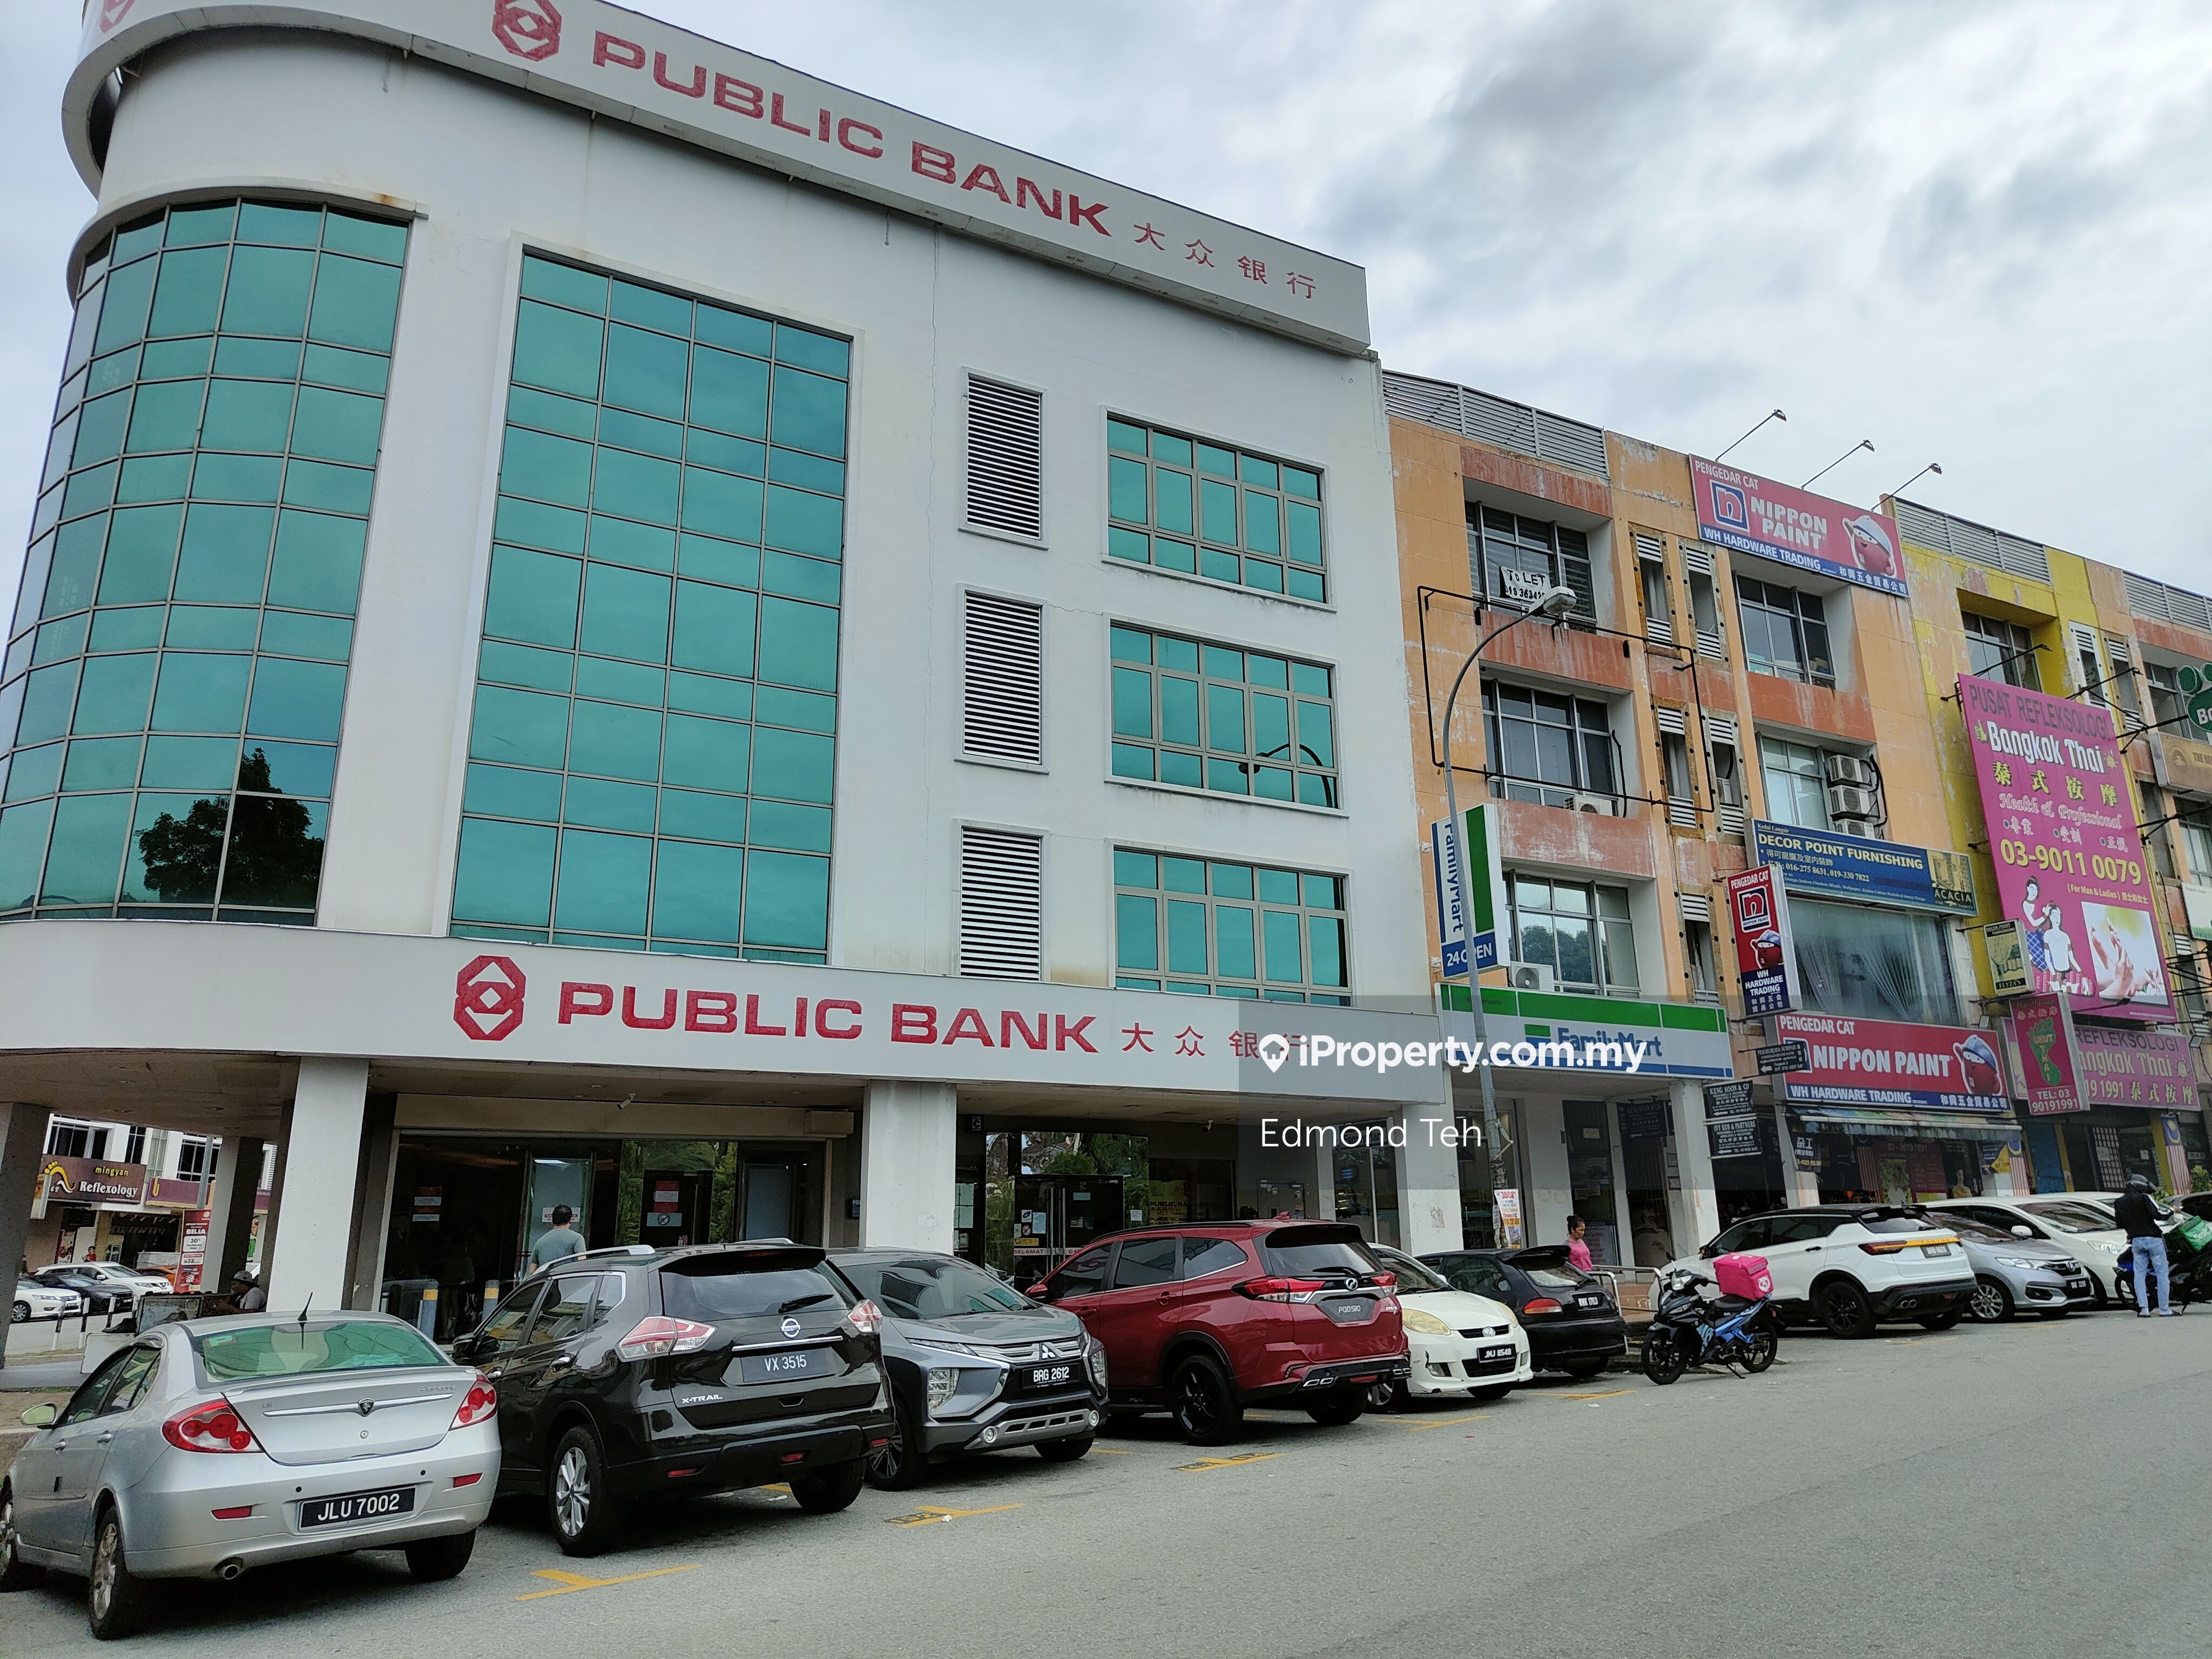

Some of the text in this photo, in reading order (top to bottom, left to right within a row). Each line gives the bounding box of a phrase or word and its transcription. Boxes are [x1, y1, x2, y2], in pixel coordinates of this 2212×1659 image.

[592, 30, 1111, 237] PUBLIC BANK
[1134, 221, 1316, 300] 大众银行
[1695, 460, 1759, 490] PENGEDAR CAT
[1751, 496, 1827, 534] NIPPON
[1762, 517, 1822, 549] PAINT
[1703, 527, 1821, 573] WH HARDWARE TRADING
[1506, 569, 1546, 586] TO LET
[1838, 566, 1906, 594] 和興五金貿易公司
[1968, 684, 2111, 741] PUSAT REFLEKSOLOGI
[1987, 720, 2106, 774] Bangkok Thai
[1992, 761, 2118, 807] 泰式按摩
[1999, 793, 2039, 814] Health
[2058, 804, 2122, 830] Professional
[1772, 826, 1789, 834] Langsir
[1758, 833, 1924, 870] DECOR POINT FURNISHING
[2000, 839, 2142, 885] 03-9011 0079
[1730, 870, 1769, 890] PENGEDAR CAT
[1785, 863, 1811, 873] 016-275
[1830, 869, 1854, 879] 019-330
[1855, 873, 1870, 882] 7822
[1934, 888, 1972, 902] ACACIA
[2081, 886, 2093, 895] Man
[1460, 943, 1492, 963] OEN
[1745, 974, 1784, 990] HARDWARE
[1756, 969, 1769, 979] WH
[1999, 979, 2021, 989] ELYZA'S
[1750, 983, 1781, 996] TRADING
[558, 981, 1099, 1054] PUBLIC BANK
[1780, 1015, 1855, 1035] PENGEDAR CAT
[2033, 1034, 2053, 1044] URUT
[1813, 1044, 1891, 1073] NIPPON
[1894, 1051, 1950, 1077] PAINT
[2079, 1049, 2174, 1078] angkok Thai
[1709, 1087, 1723, 1095] KENG
[1724, 1084, 1737, 1093] SOON
[1790, 1085, 1809, 1098] WH
[1811, 1086, 1867, 1101] HARDWARE
[1868, 1090, 1912, 1103] TRADING
[2036, 1088, 2071, 1100] TEL: 03
[2085, 1079, 2125, 1099] 19 1991
[2130, 1081, 2194, 1105] 泰式按摩
[1940, 1094, 2007, 1109] 和興五金貿易公司
[2032, 1097, 2079, 1112] 90191991
[1735, 1120, 1756, 1129] PARTNERS
[95, 1166, 129, 1177] mingyan
[79, 1181, 138, 1198] Reflexology
[764, 1354, 807, 1372] VX 3515
[1033, 1366, 1070, 1382] BRG 2612
[681, 1393, 723, 1404] X-TRAIL
[318, 1493, 400, 1521] JLU 7002
